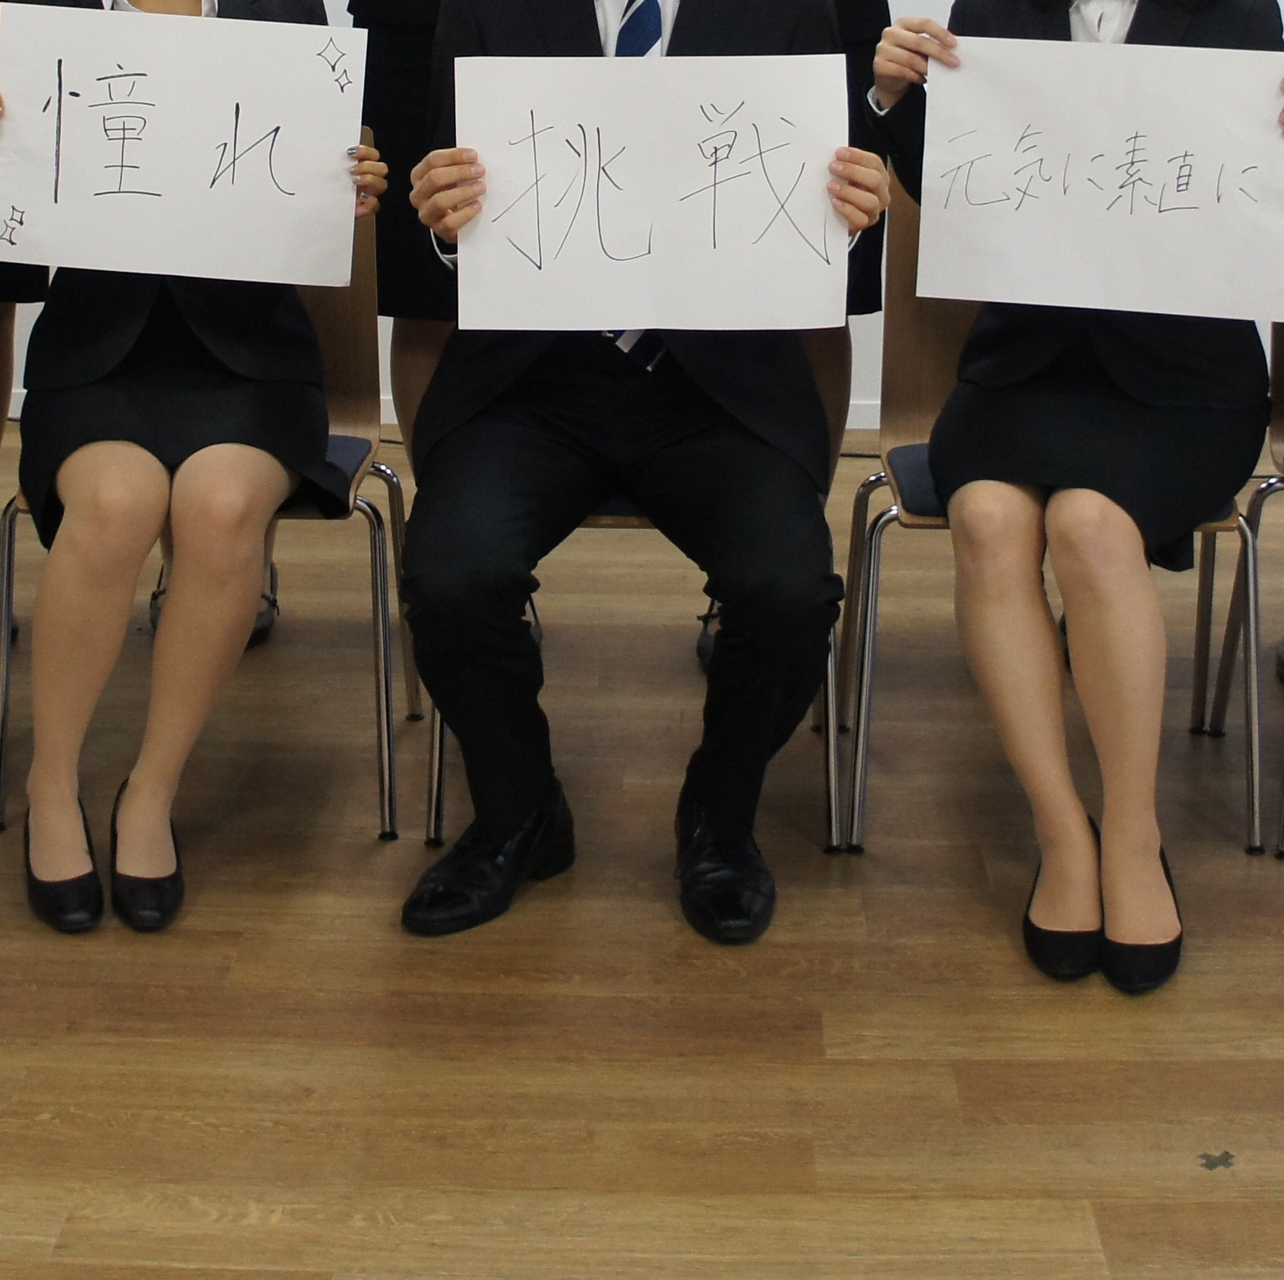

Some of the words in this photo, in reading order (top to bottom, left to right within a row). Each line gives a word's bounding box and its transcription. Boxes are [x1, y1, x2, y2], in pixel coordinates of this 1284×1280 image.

[42, 58, 296, 205] 憧れ
[491, 100, 831, 271] 挑戦
[940, 123, 1259, 216] 元気に素直に
